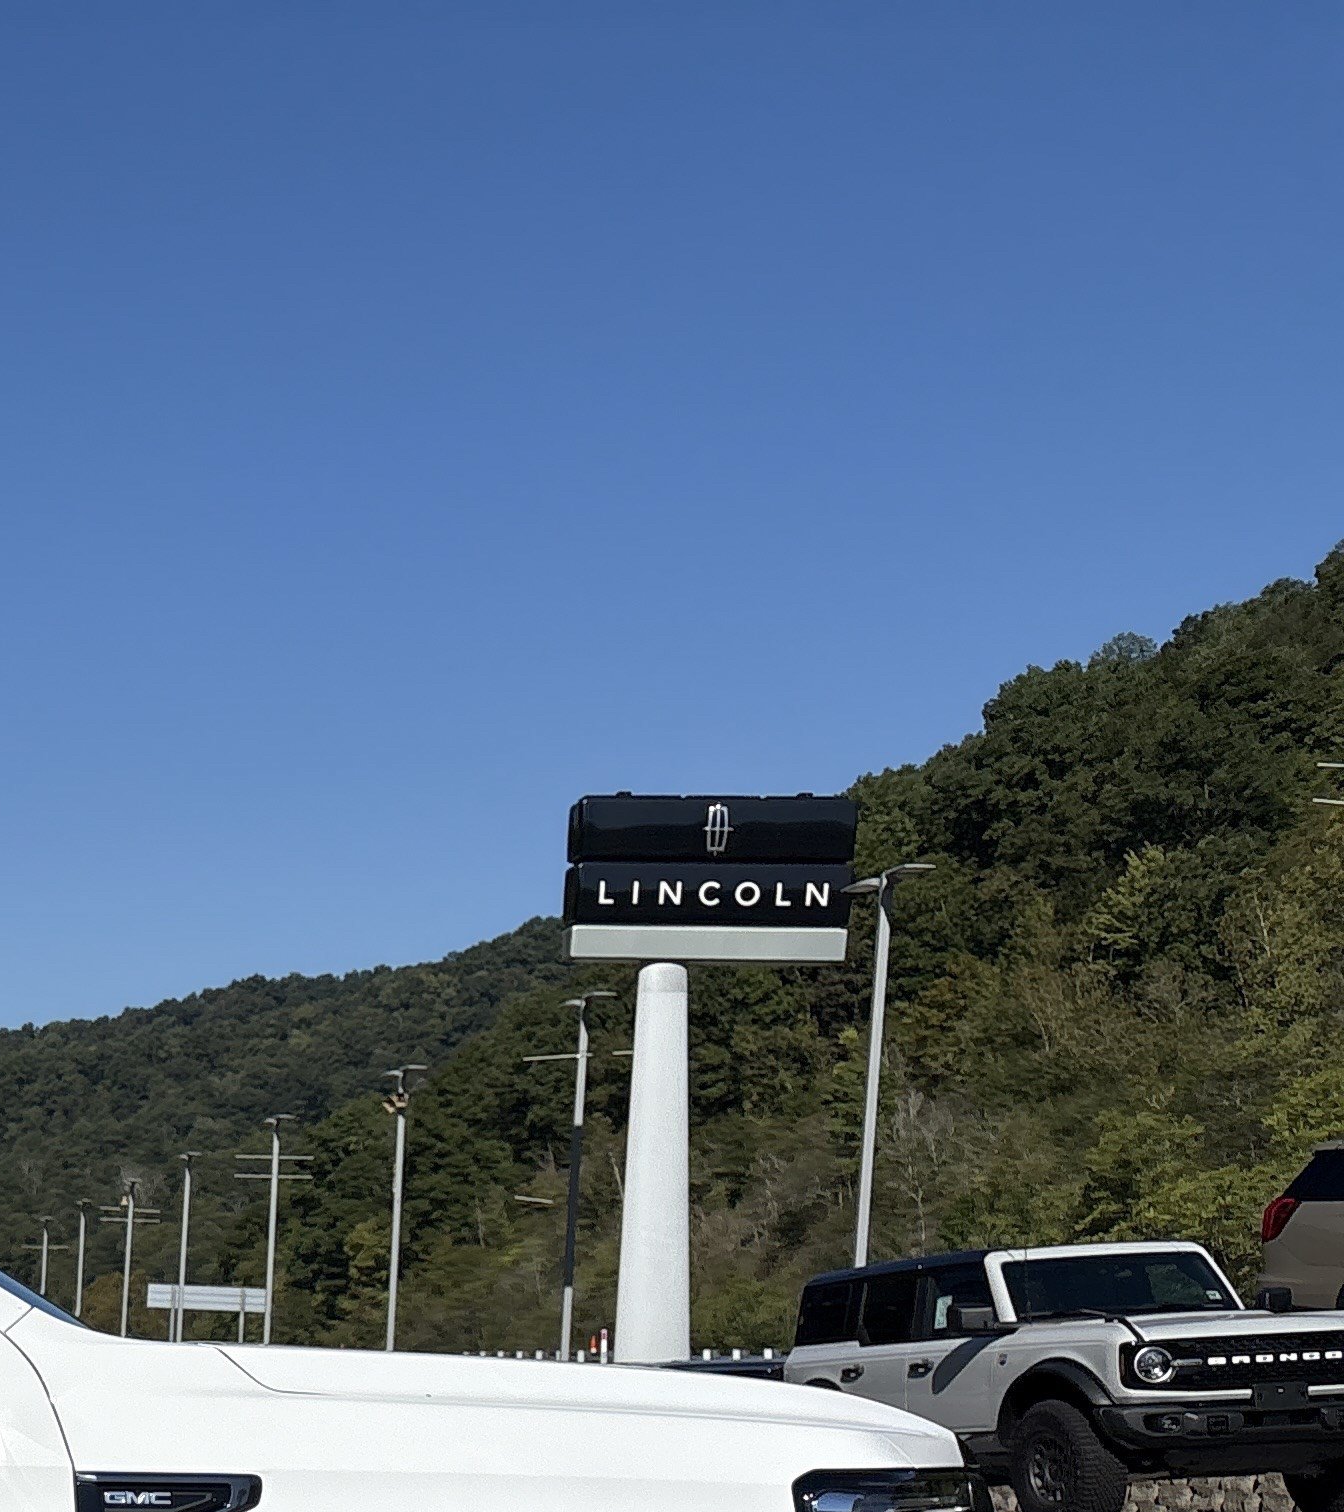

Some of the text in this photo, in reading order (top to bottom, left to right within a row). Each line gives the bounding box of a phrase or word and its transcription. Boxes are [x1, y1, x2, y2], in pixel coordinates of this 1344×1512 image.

[597, 880, 830, 907] LINCOLN
[1207, 1350, 1344, 1366] BRONCO
[103, 1490, 172, 1505] GMC
